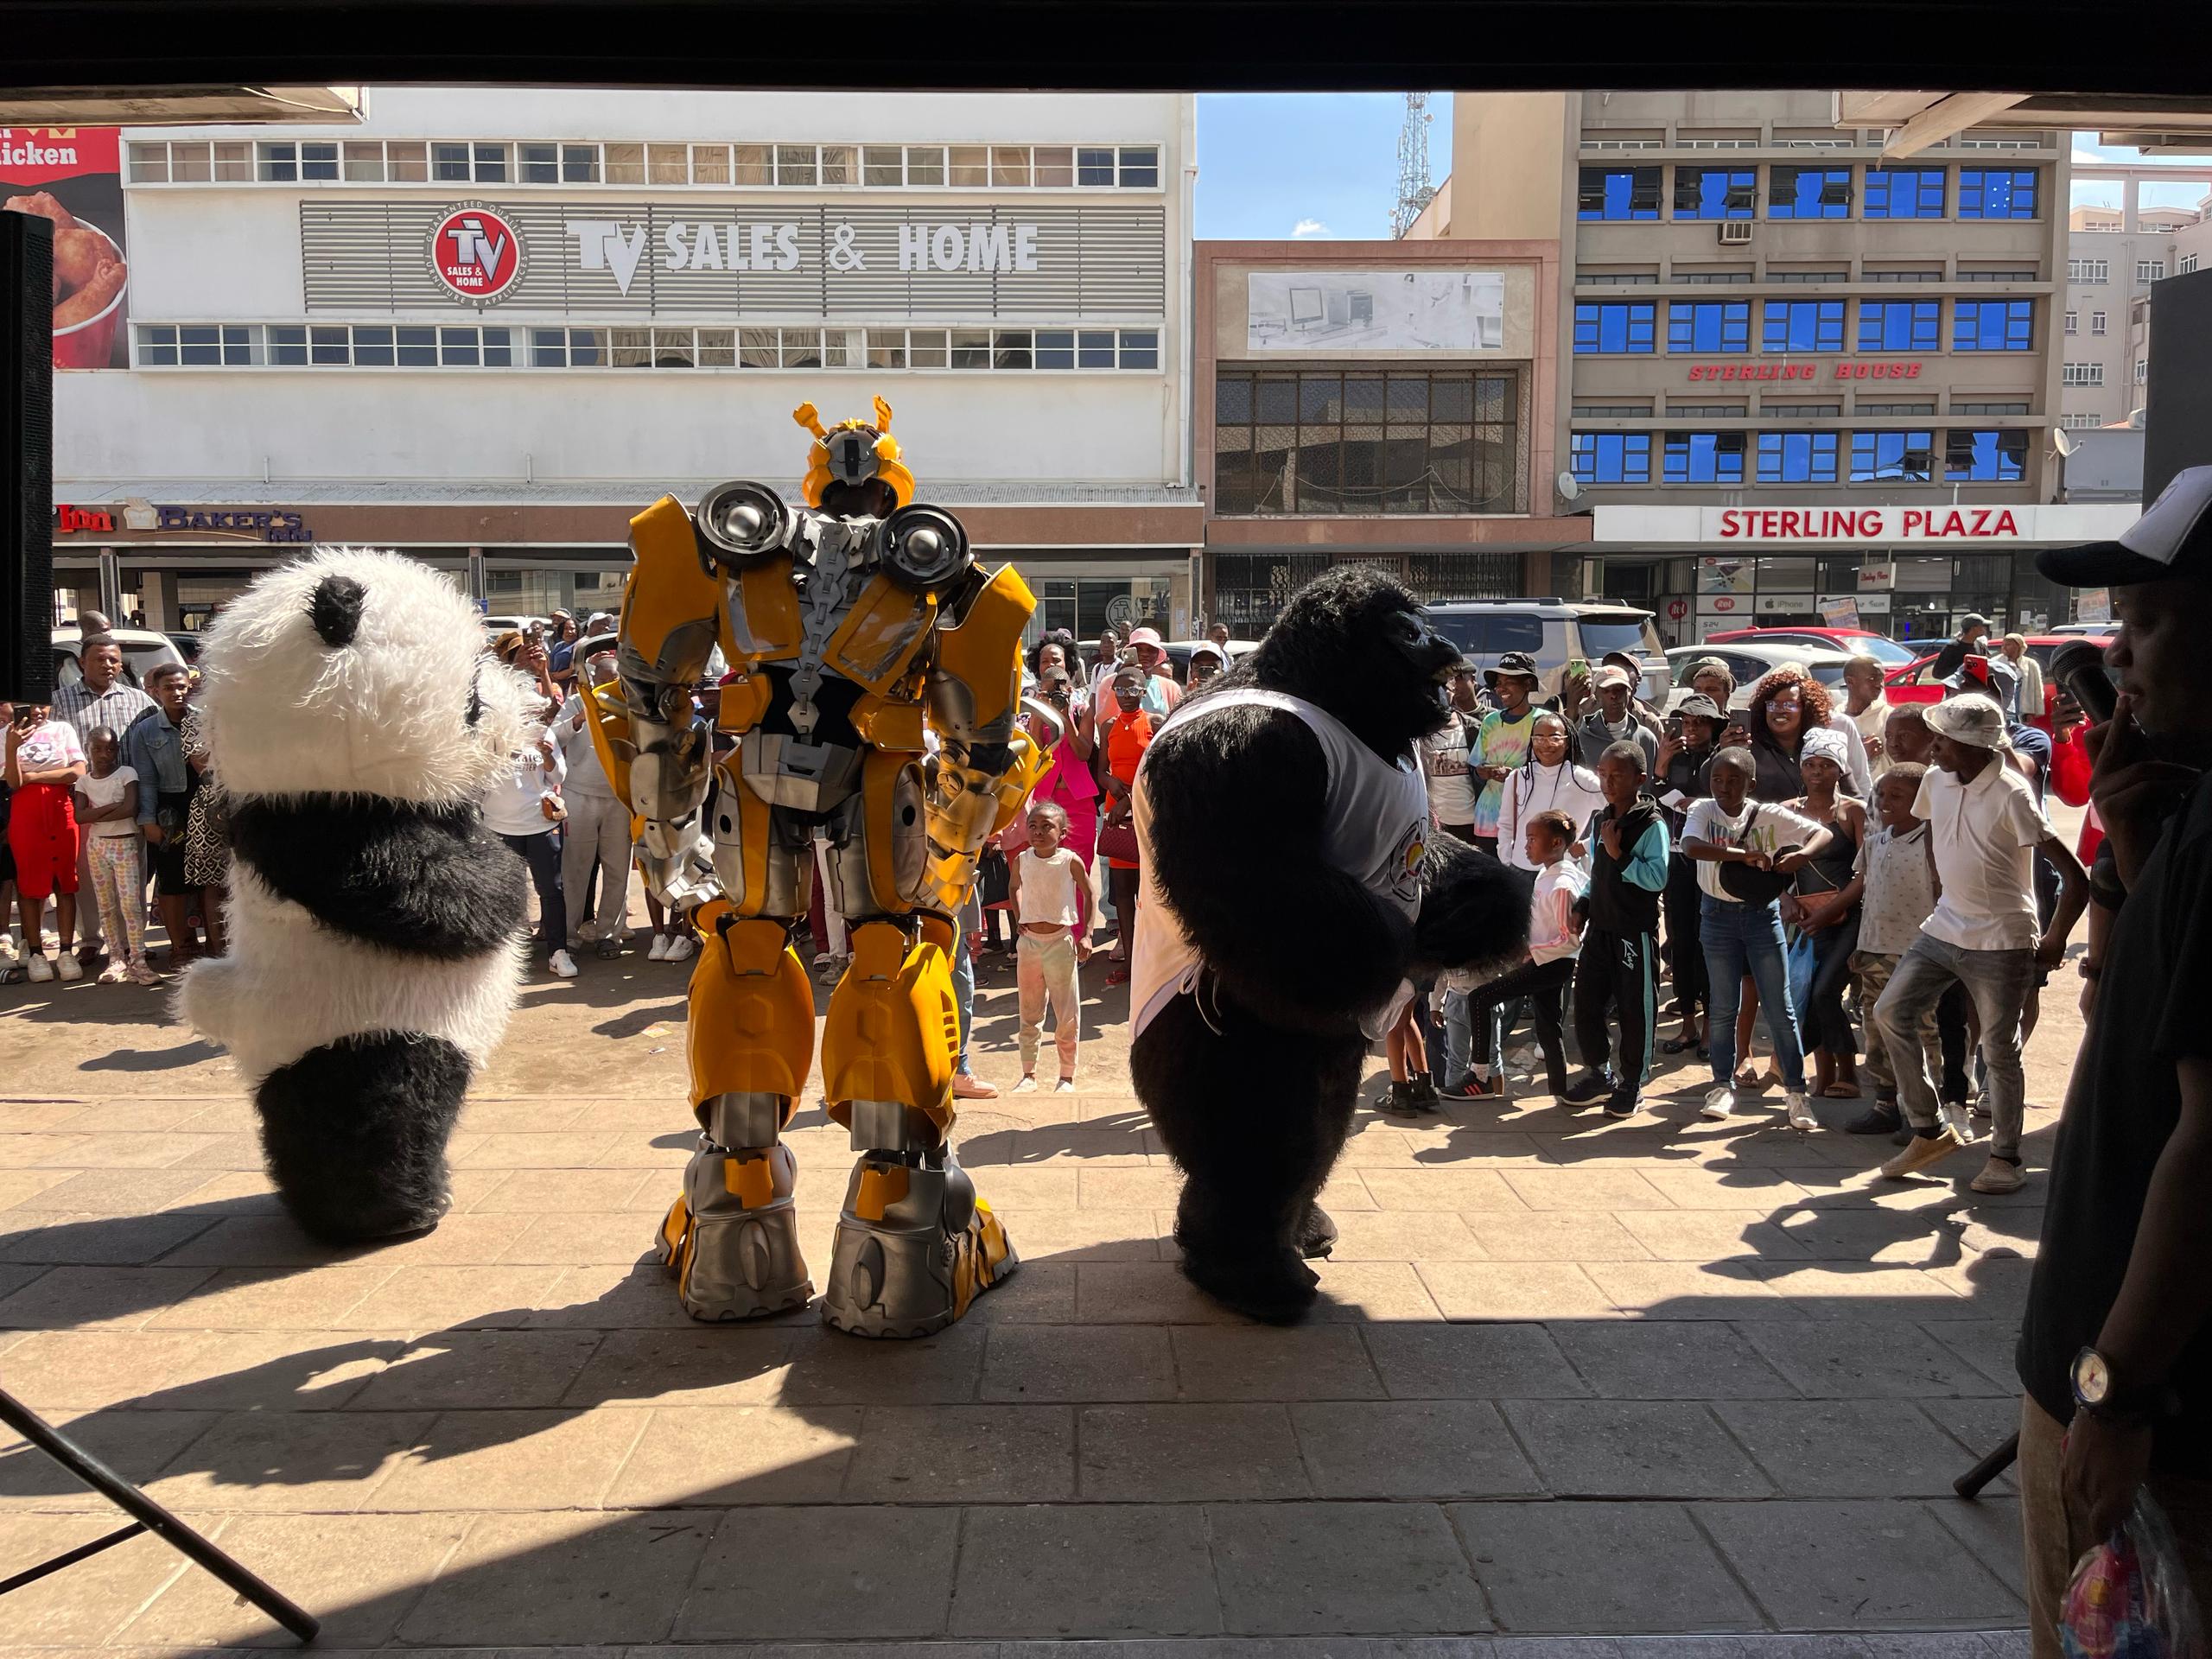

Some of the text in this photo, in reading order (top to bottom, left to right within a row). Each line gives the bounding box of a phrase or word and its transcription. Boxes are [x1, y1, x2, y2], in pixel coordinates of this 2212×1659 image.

[0, 141, 78, 165] icken
[426, 200, 524, 243] GUARANTEED QUALITY
[447, 219, 506, 284] TV
[565, 221, 1039, 298] TV SALES & HOME
[424, 254, 467, 304] FURNITURE
[485, 255, 528, 306] APPLIANCES
[447, 266, 483, 276] SALES &
[456, 276, 484, 287] HOME
[1688, 362, 1923, 382] STERLING HOUSE
[56, 504, 115, 533] Inn
[1719, 509, 2018, 538] STERLING PLAZA
[1777, 600, 1804, 608] iPhone
[1621, 938, 1638, 970] King
